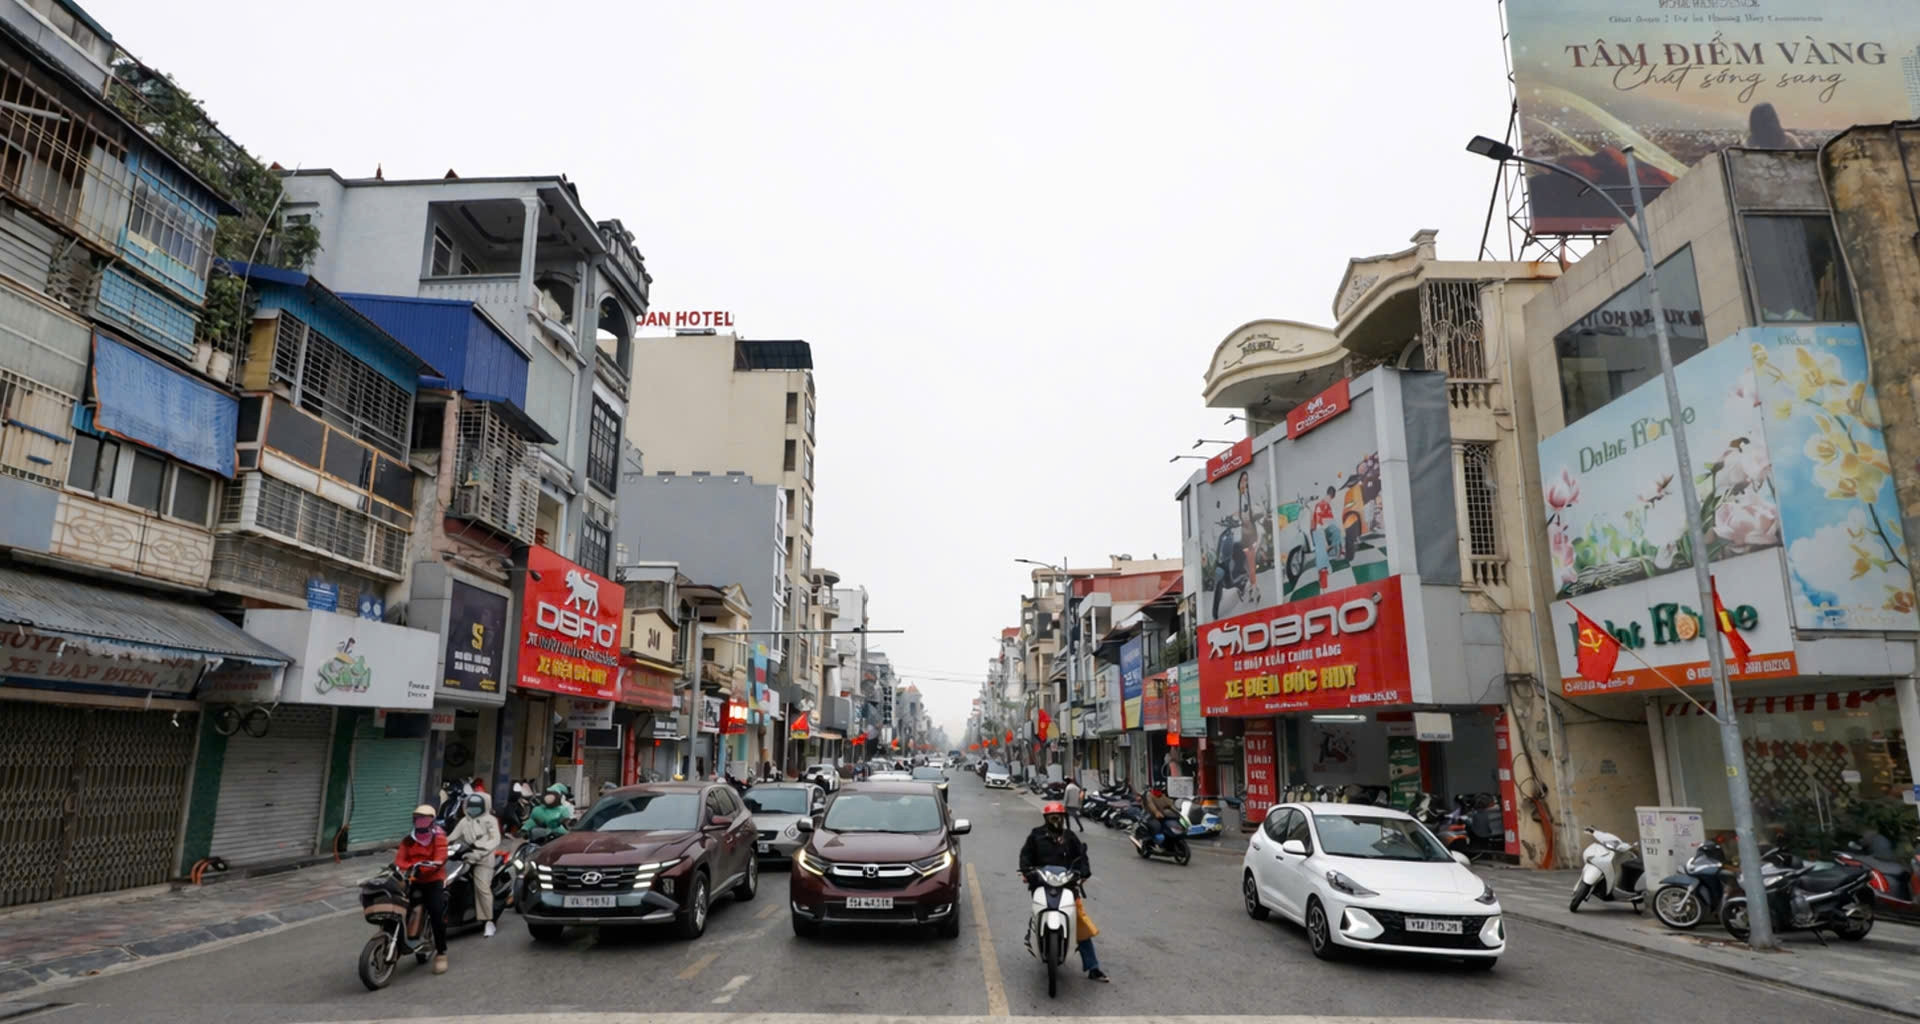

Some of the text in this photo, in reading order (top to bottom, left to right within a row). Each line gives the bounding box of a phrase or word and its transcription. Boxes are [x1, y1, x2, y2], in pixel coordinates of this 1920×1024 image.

[1564, 30, 1887, 68] TÂM ĐIỂM VÀNG
[675, 311, 734, 327] HOTEL
